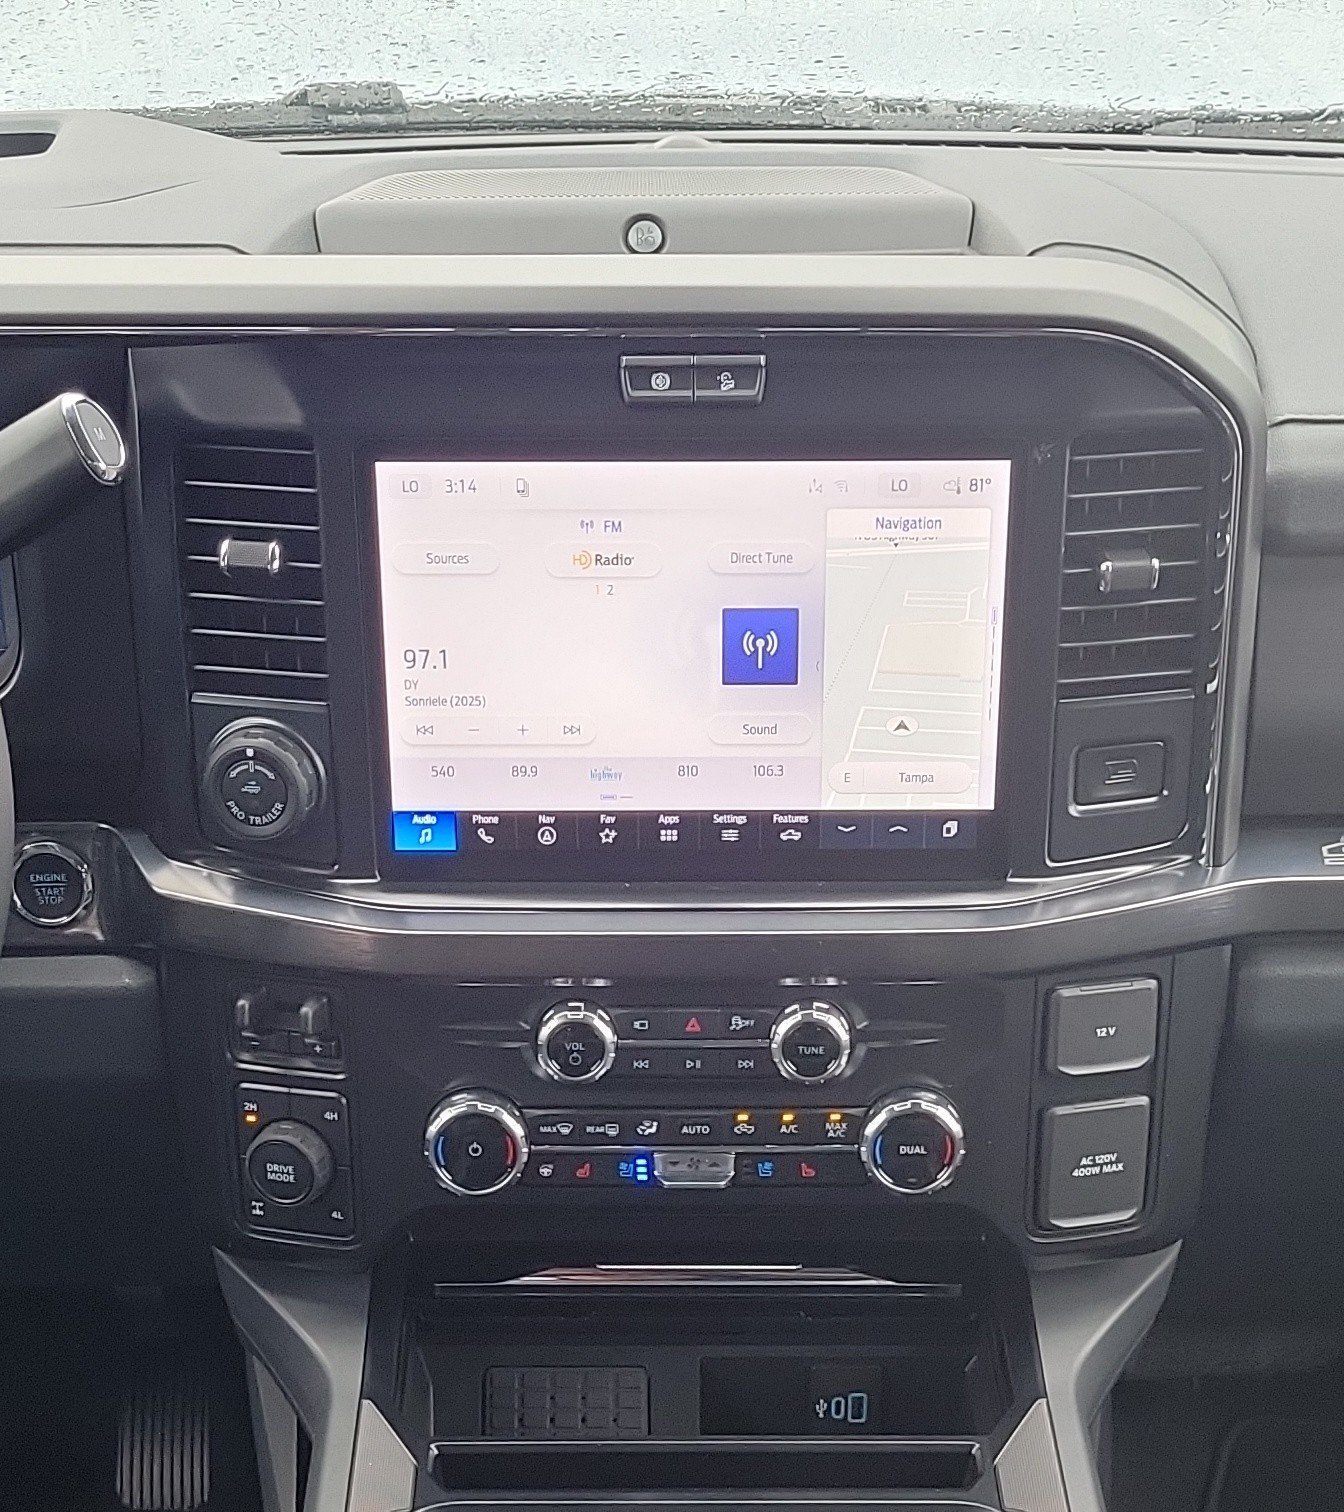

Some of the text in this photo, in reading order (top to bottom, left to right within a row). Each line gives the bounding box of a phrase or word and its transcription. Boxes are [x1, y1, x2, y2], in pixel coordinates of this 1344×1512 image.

[401, 479, 477, 494] LO 3:14
[891, 479, 908, 493] LO
[968, 478, 992, 493] 81°
[603, 520, 623, 534] FM
[875, 516, 942, 532] Navigation
[425, 552, 470, 566] Sources
[594, 553, 632, 567] Radio
[730, 552, 794, 565] Direct Tune
[606, 584, 614, 596] 2
[403, 648, 448, 670] 97.1
[404, 679, 419, 691] DY
[404, 695, 487, 709] Sonriele (2025)
[741, 723, 778, 736] Sound
[430, 765, 455, 779] 540
[511, 765, 539, 779] 89.9
[677, 765, 699, 778] 810
[753, 765, 785, 778] 106.3
[843, 772, 852, 784] E
[898, 772, 935, 785] Tampa
[226, 800, 285, 825] PRO TRAILER
[412, 814, 437, 825] Audio
[472, 814, 500, 825] Phone
[538, 814, 556, 825] Nav
[599, 814, 617, 825] Fav
[658, 814, 680, 826] Apps
[712, 813, 748, 826] Settings
[772, 814, 809, 825] Features
[29, 873, 68, 883] ENGINE
[35, 887, 65, 896] START
[38, 896, 64, 905] STOP
[564, 1041, 585, 1052] VOL
[797, 1045, 826, 1055] TUNE
[243, 1101, 258, 1112] 2H
[323, 1111, 339, 1121] 4H
[681, 1124, 710, 1136] AUTO
[779, 1124, 799, 1134] A/C
[825, 1122, 848, 1131] MAX
[827, 1129, 846, 1138] A/C
[898, 1145, 928, 1155] DUAL
[1080, 1152, 1118, 1166] AC 120V
[266, 1162, 295, 1174] DRIVE
[1071, 1162, 1125, 1178] 400W MAX
[266, 1171, 297, 1183] MODE
[331, 1210, 345, 1220] 4L
